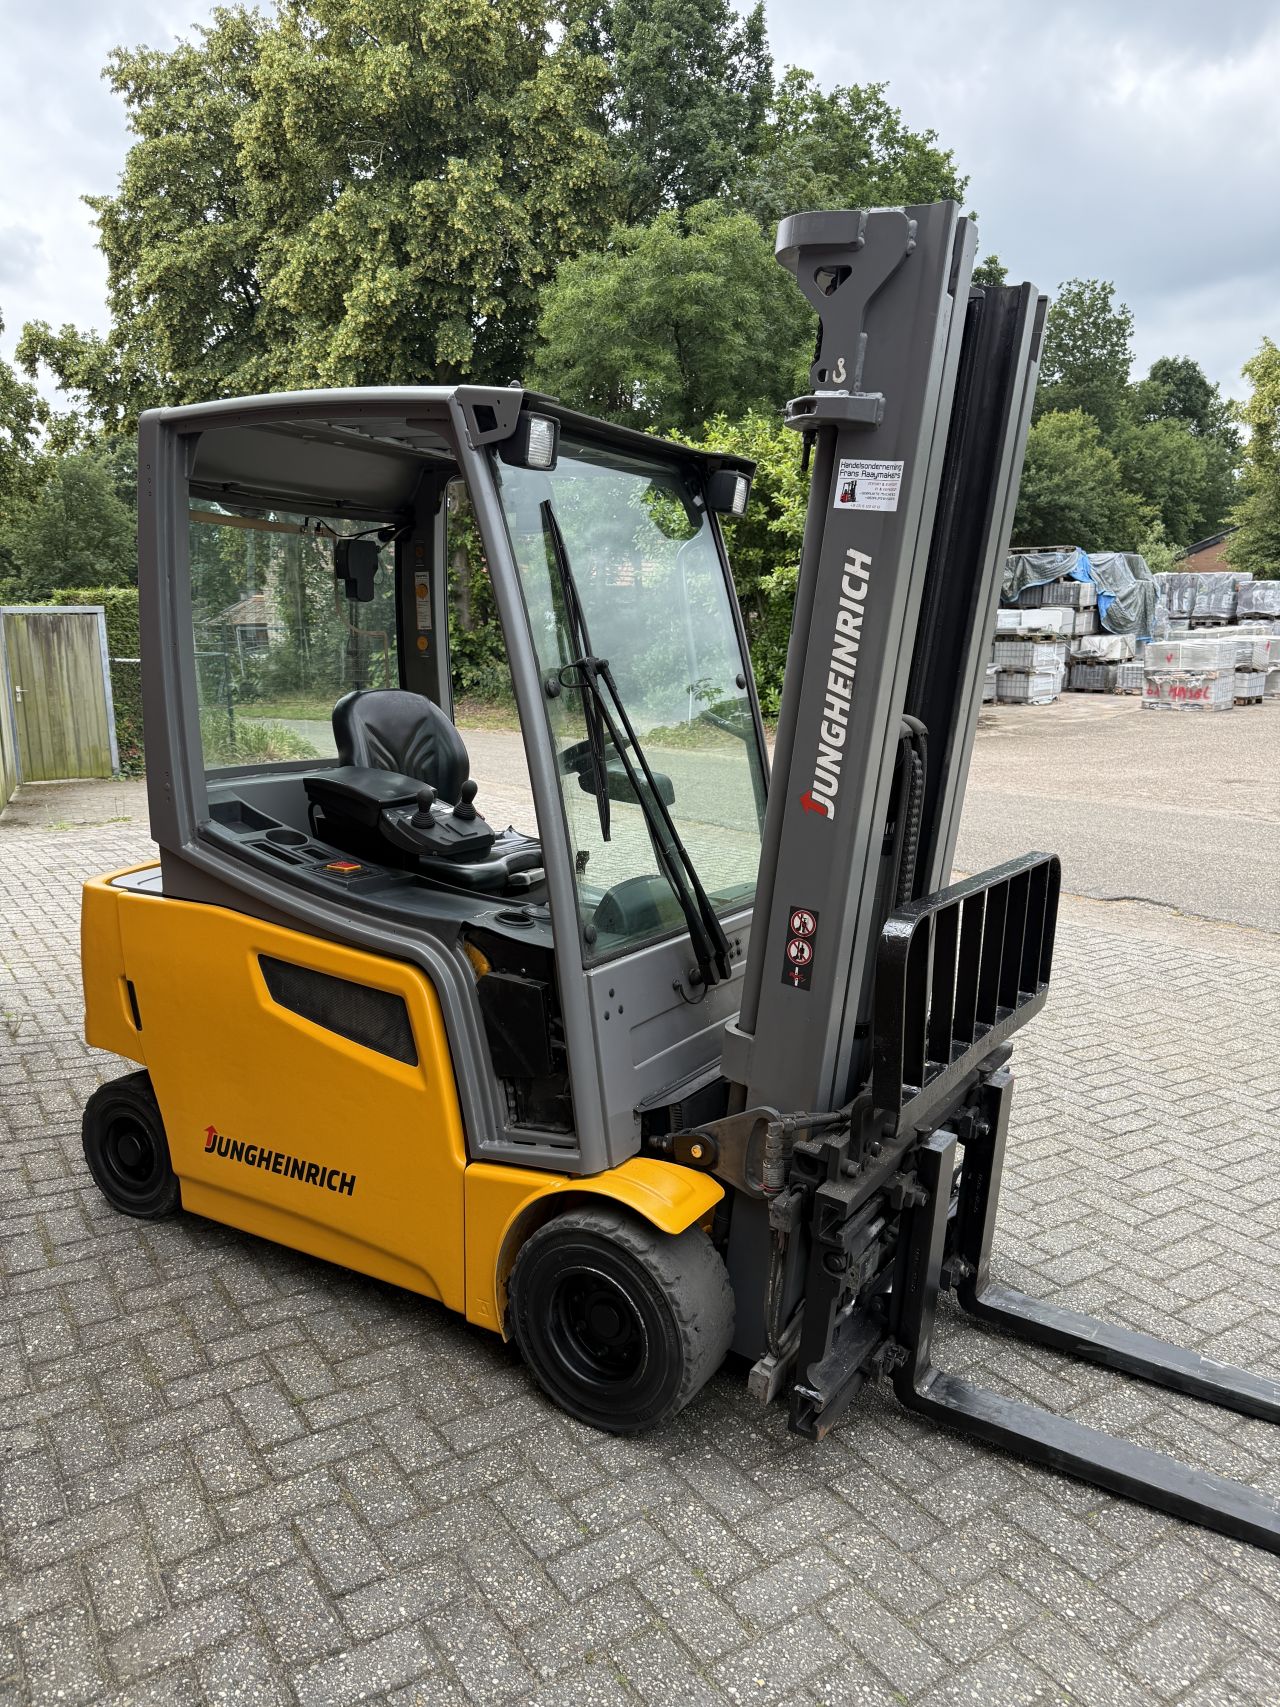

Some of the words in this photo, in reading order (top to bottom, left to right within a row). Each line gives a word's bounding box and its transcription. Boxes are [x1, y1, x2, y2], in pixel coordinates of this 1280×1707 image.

[840, 469, 859, 477] Frans
[861, 470, 901, 479] Raaymakers
[841, 461, 902, 472] Handelsonderneming
[812, 548, 872, 820] JUNGHEINRICH
[205, 1134, 356, 1196] JUNGHEINRICH
